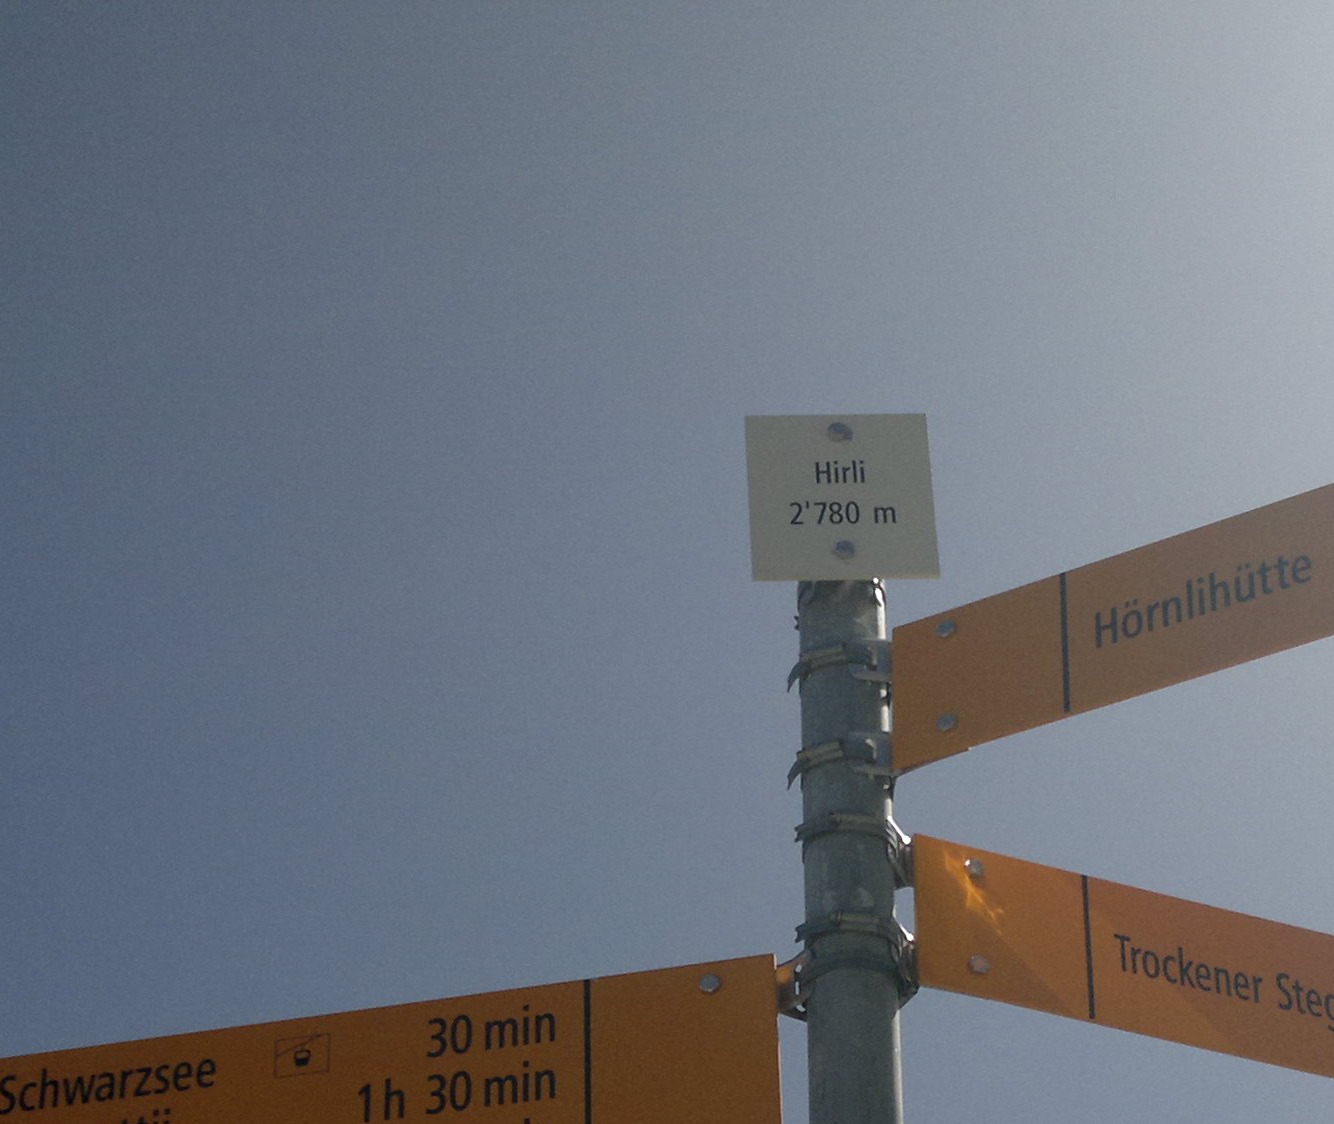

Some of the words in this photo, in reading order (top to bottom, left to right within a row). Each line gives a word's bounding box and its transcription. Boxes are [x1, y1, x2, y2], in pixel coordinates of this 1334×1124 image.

[815, 459, 866, 484] Hirli
[790, 501, 861, 525] 2'780
[874, 507, 897, 524] m
[1094, 553, 1314, 649] Hörnlihütte
[1114, 934, 1263, 1003] Trockener
[427, 1014, 473, 1059] 30
[485, 1005, 557, 1050] min
[425, 1070, 473, 1115] 30
[485, 1061, 557, 1107] min
